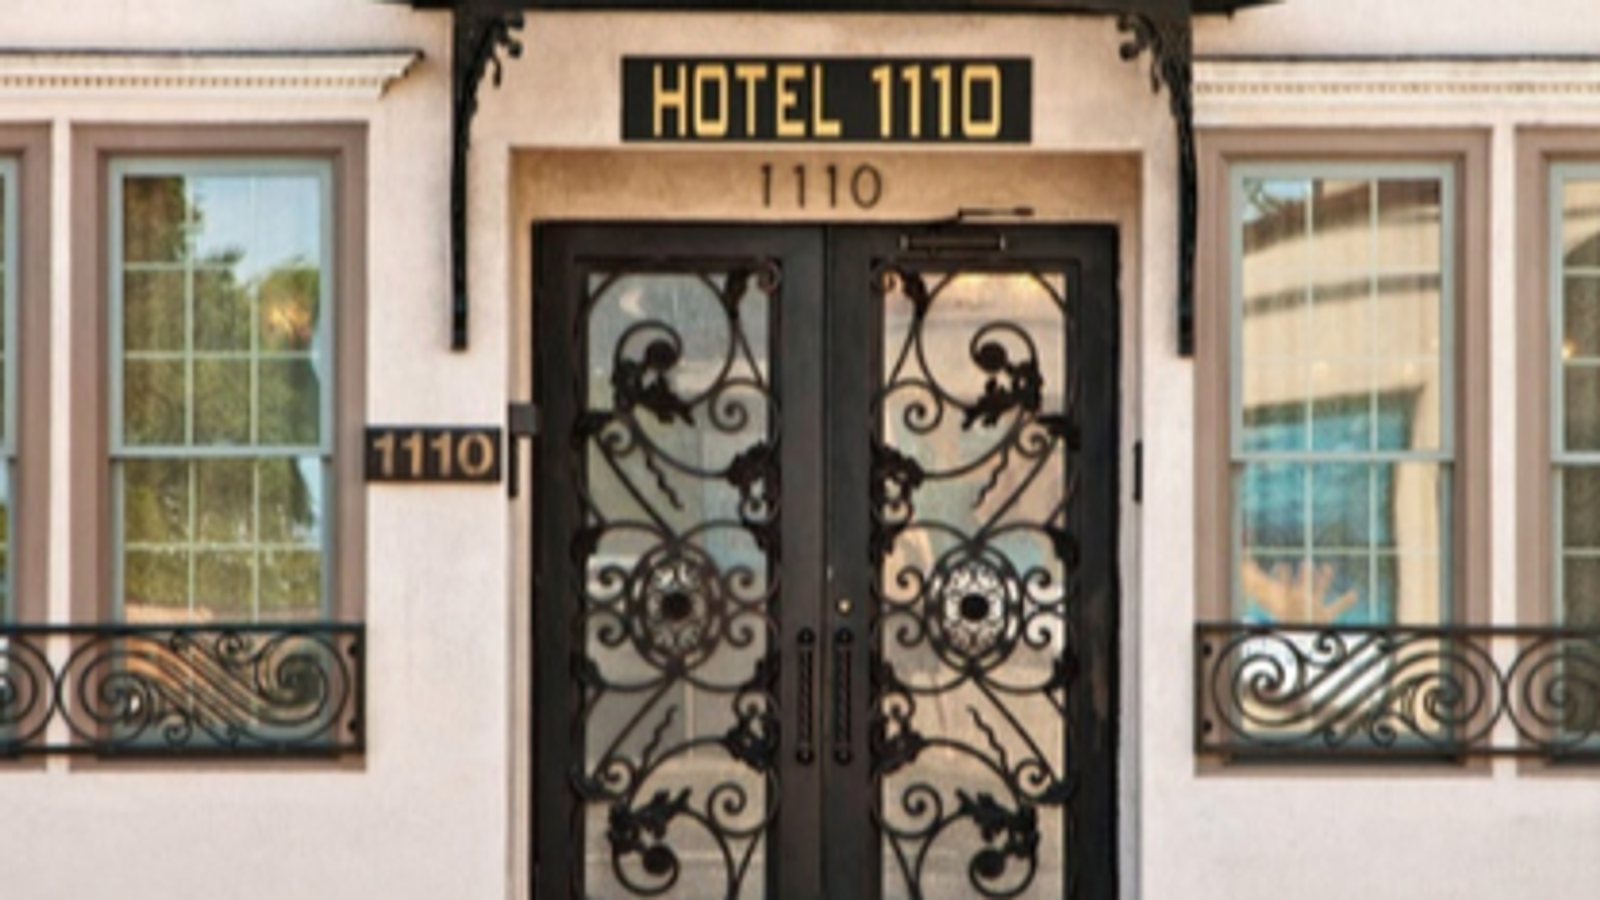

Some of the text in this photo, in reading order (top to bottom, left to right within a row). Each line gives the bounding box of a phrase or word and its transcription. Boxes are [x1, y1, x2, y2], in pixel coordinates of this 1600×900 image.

[653, 63, 1001, 138] HOTEL 1110
[760, 162, 883, 209] 1110
[372, 430, 495, 477] 1110
